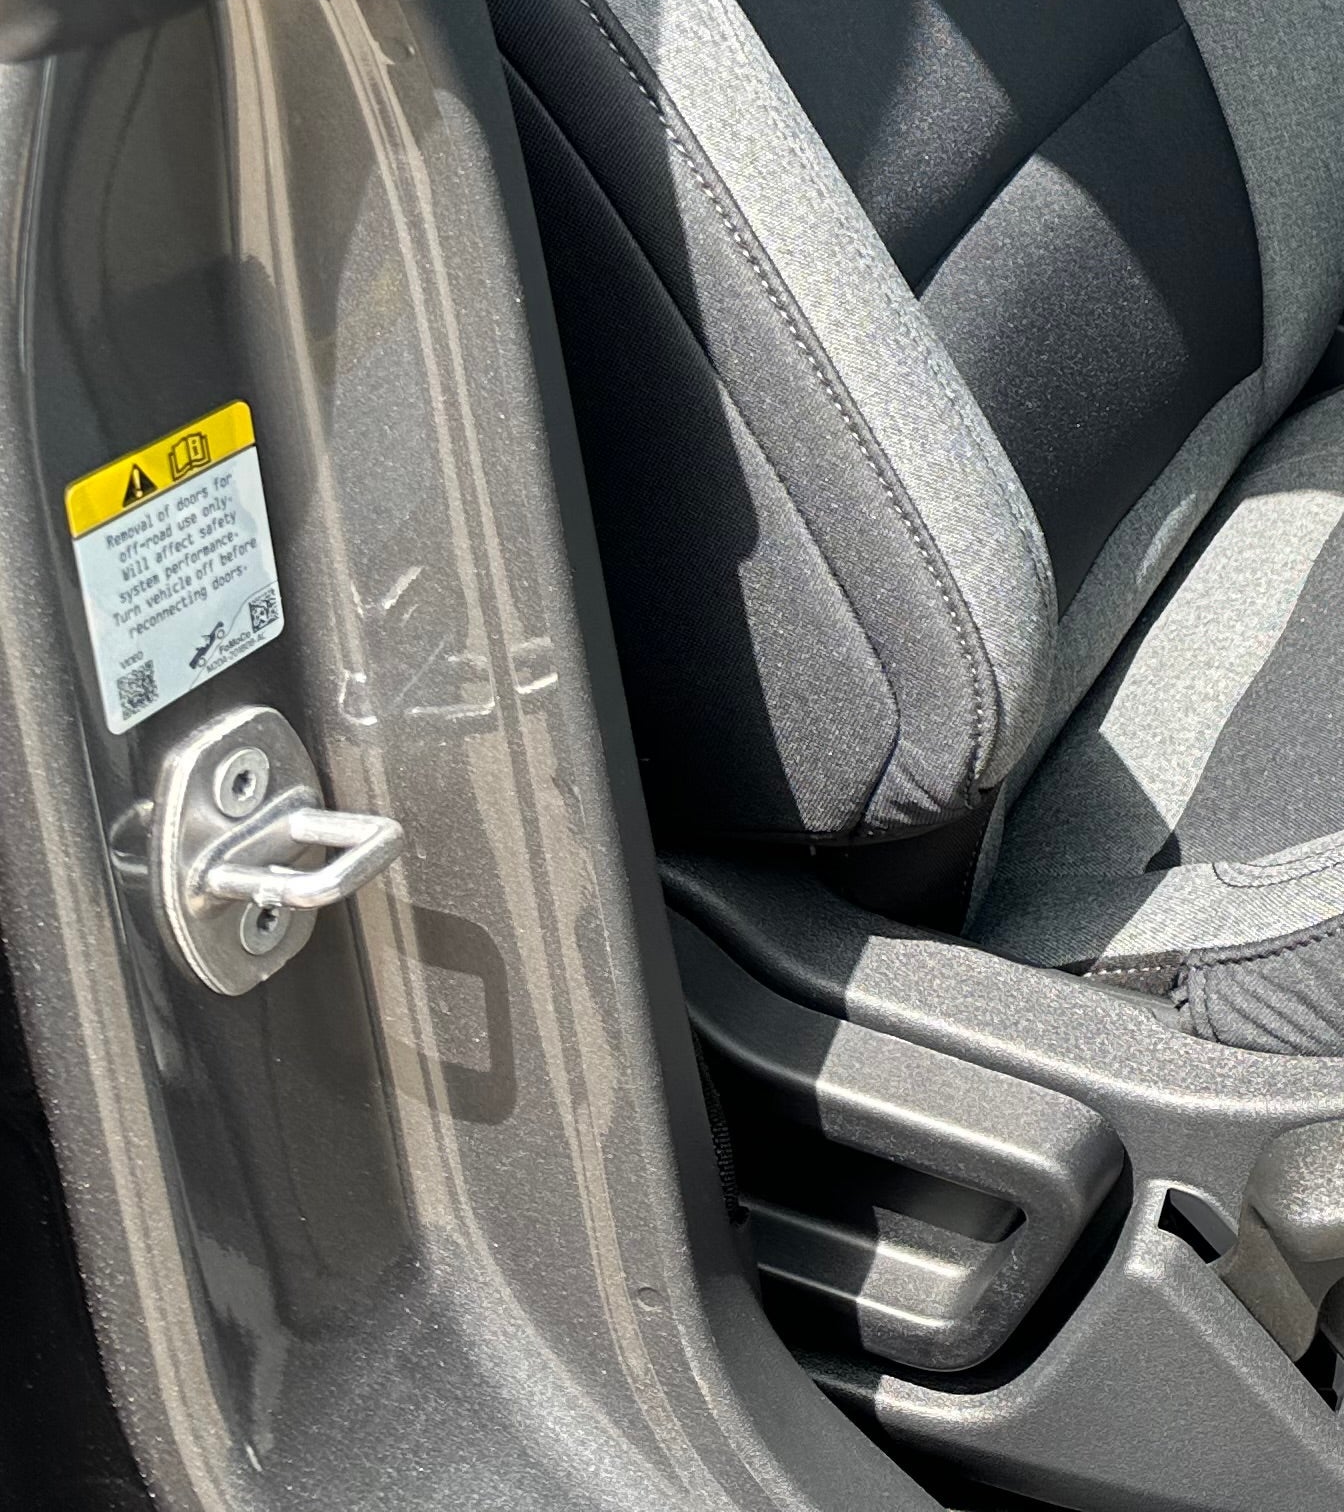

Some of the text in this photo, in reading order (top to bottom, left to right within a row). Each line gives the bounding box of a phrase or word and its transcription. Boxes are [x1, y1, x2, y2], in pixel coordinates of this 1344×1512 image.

[105, 473, 233, 550] Removal of doors for
[119, 495, 233, 564] off-road use only.
[122, 510, 237, 581] Will affect safety
[112, 537, 257, 627] Turn vehicle off before
[120, 531, 239, 604] system performance.
[128, 565, 248, 639] reconnecting doors.
